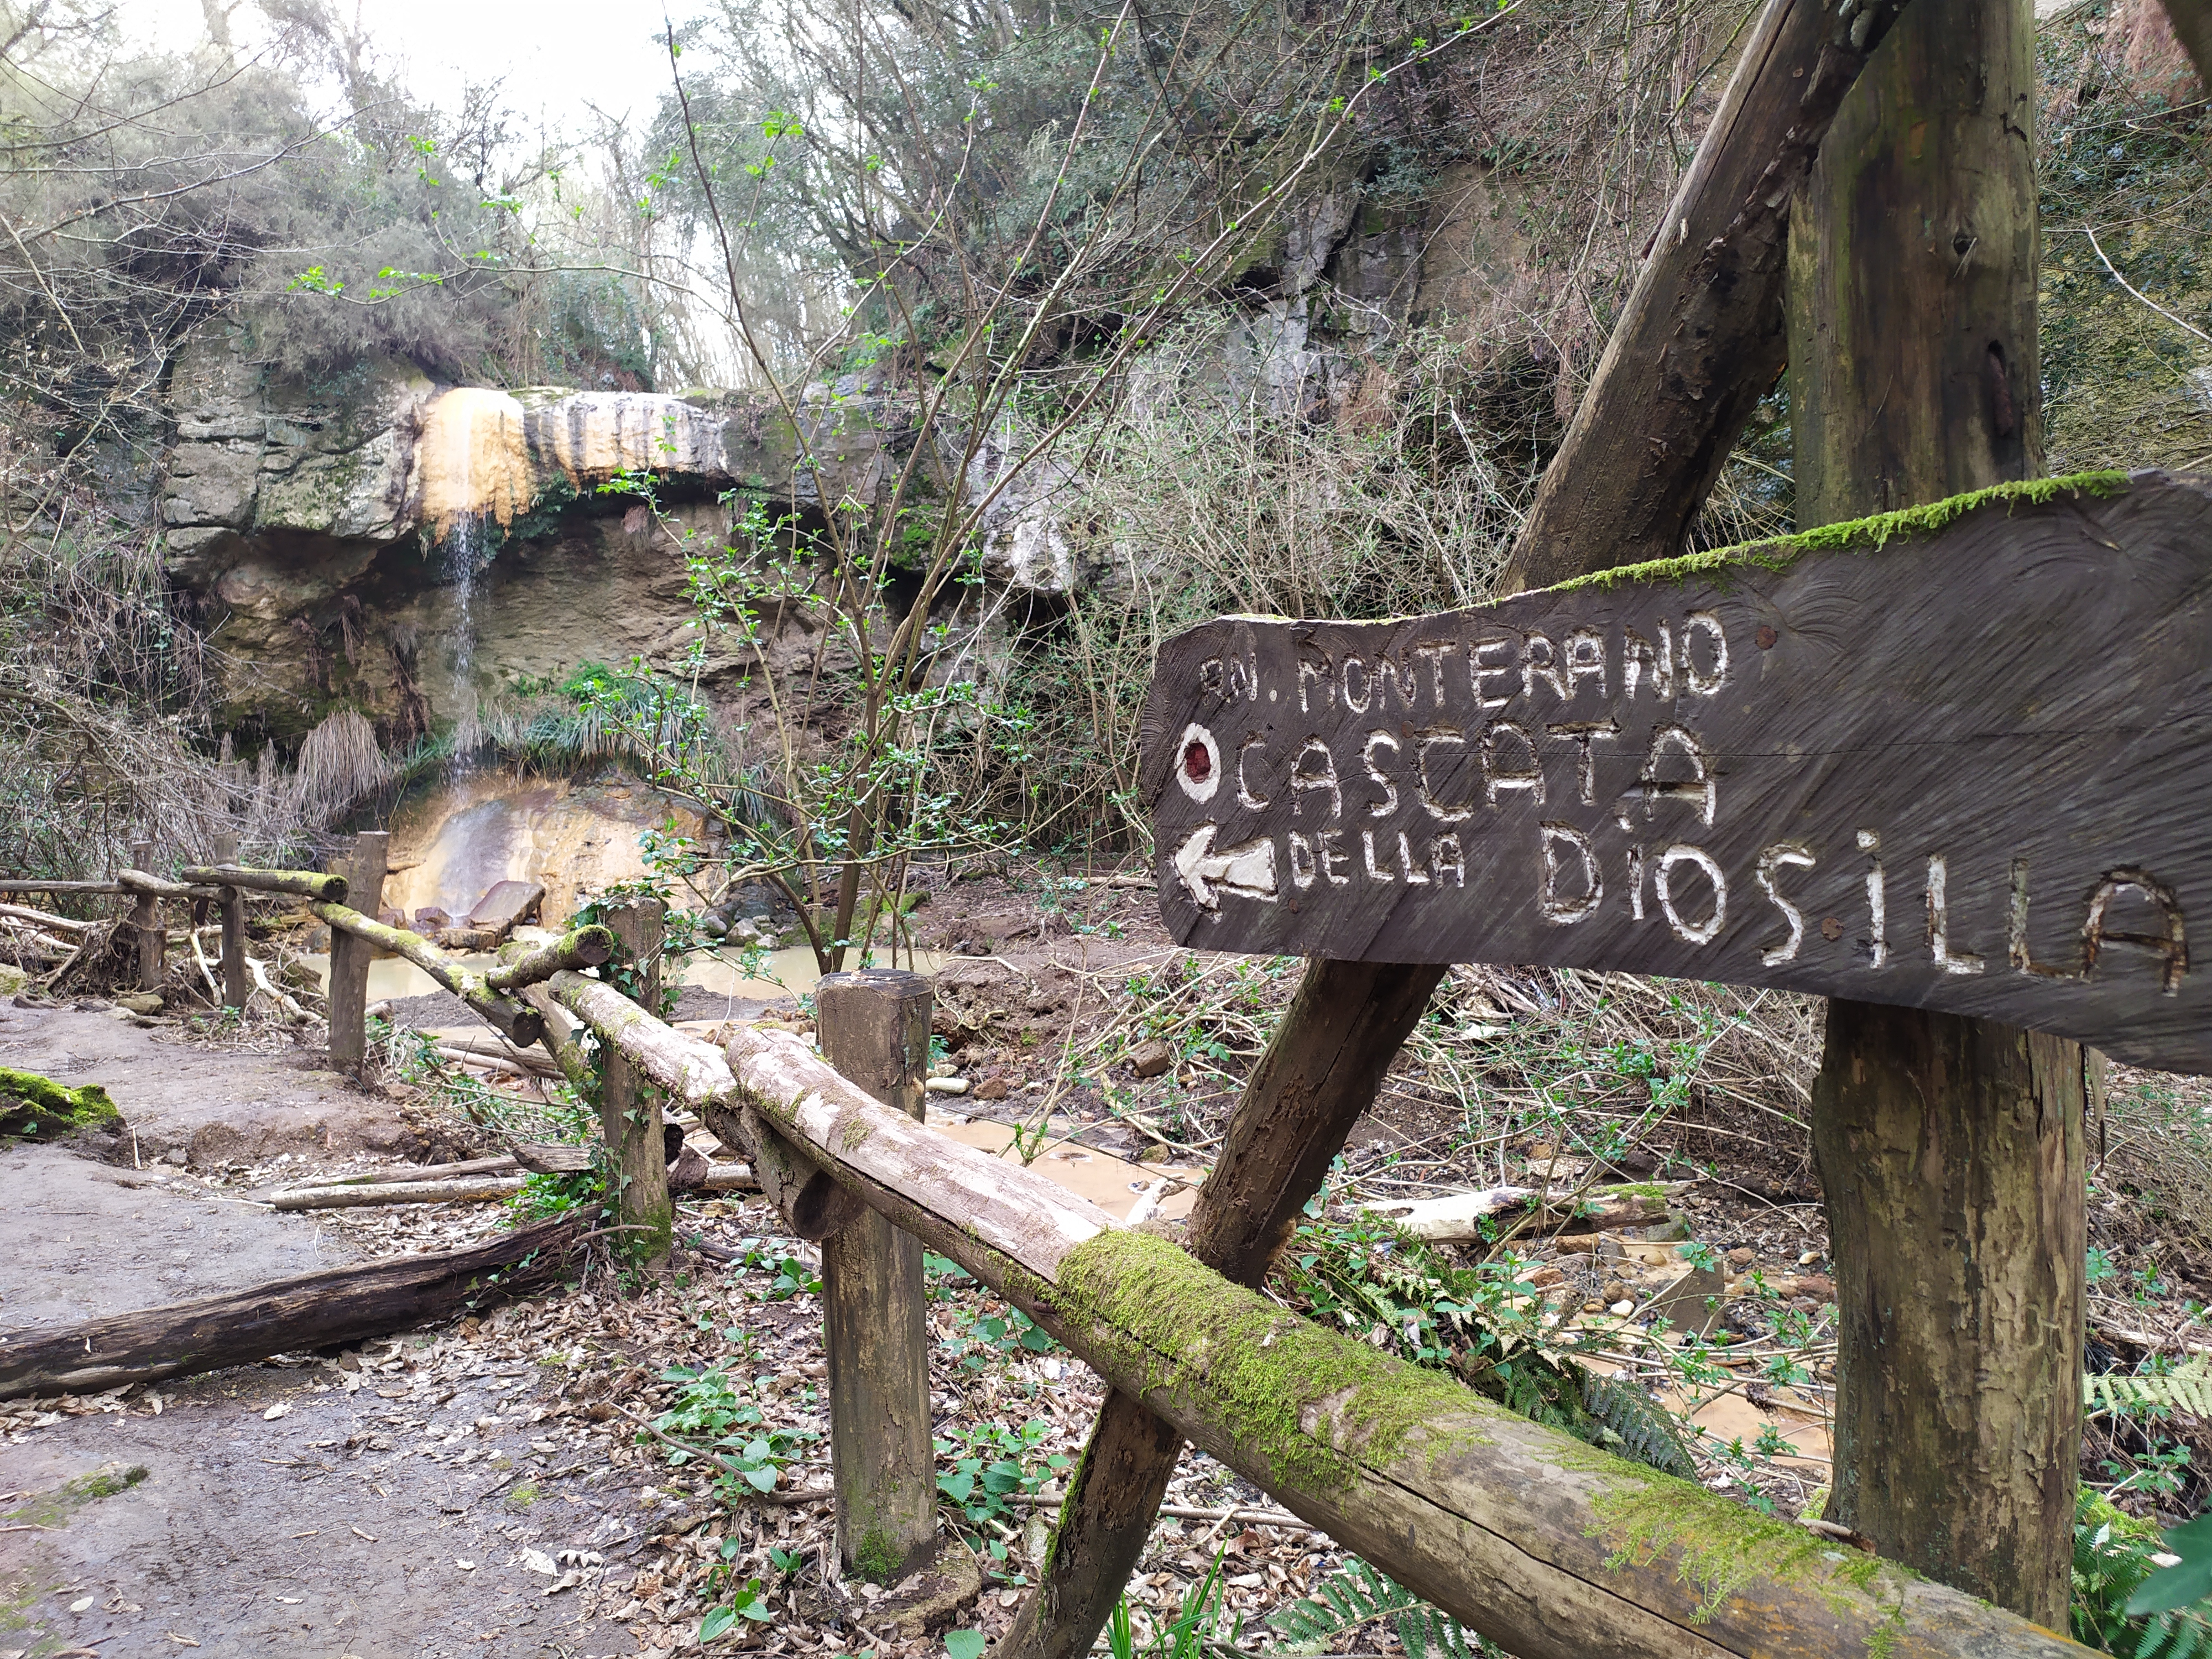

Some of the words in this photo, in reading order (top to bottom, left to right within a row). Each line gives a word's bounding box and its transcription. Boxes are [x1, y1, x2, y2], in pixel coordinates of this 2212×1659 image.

[1296, 608, 1731, 713] MONTERANO
[1234, 717, 1718, 830] CASCATA
[1287, 827, 1465, 889] DELLA
